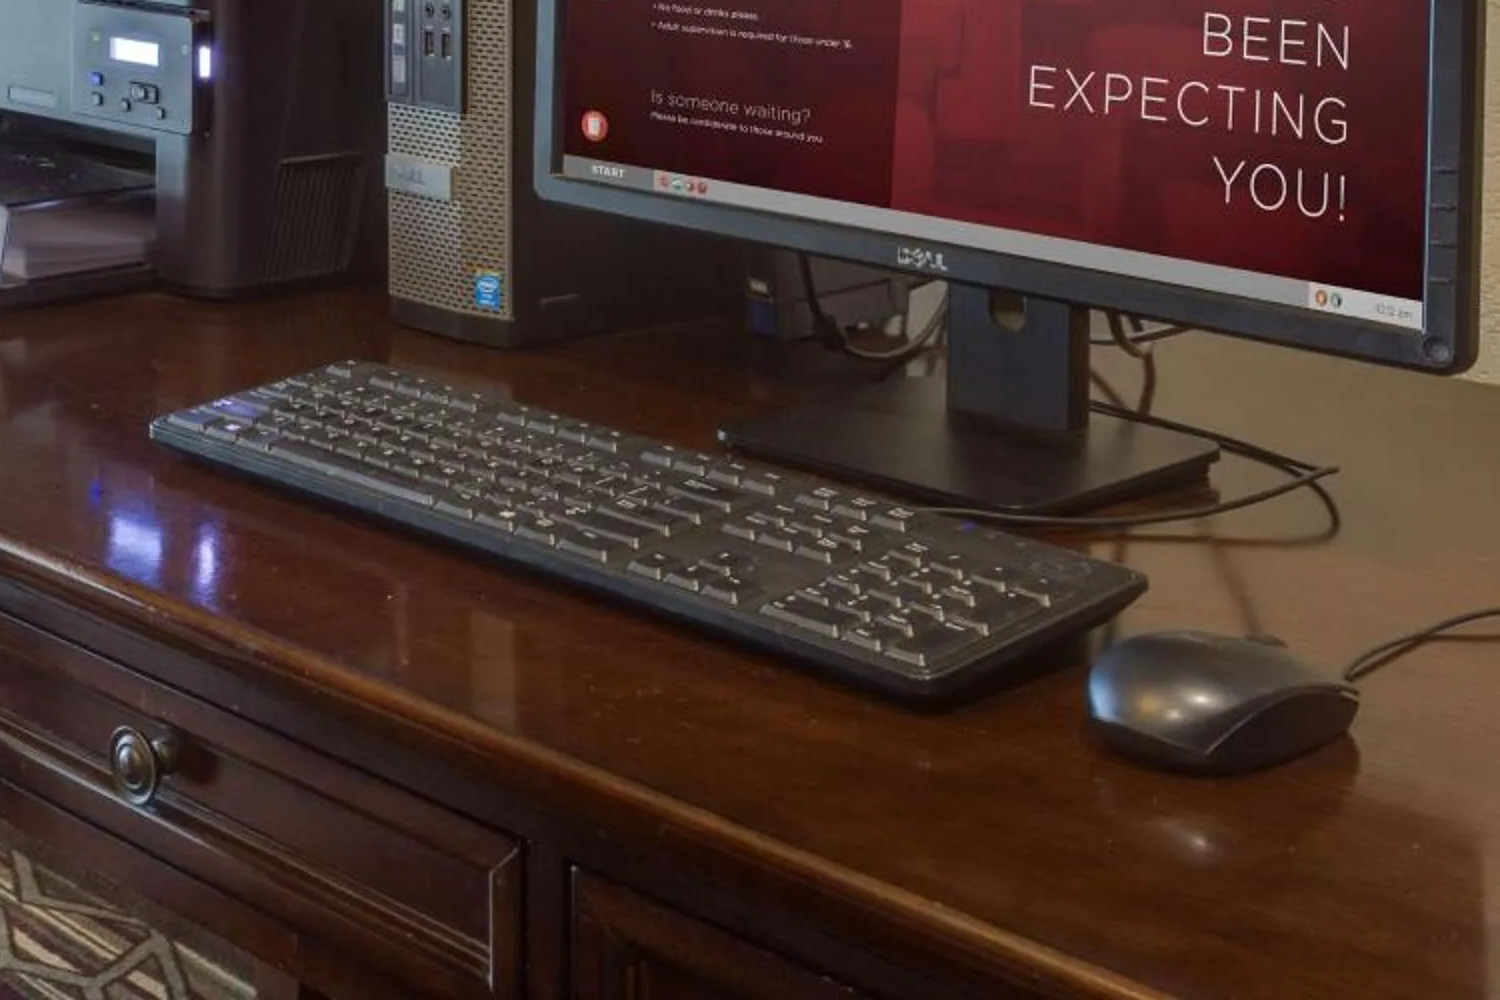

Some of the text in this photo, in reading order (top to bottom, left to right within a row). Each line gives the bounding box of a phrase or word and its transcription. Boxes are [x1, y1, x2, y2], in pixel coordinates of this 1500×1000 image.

[1202, 11, 1350, 71] BEEN
[651, 88, 812, 127] Is someone waiting?
[1028, 64, 1349, 146] EXPECTING
[590, 164, 626, 179] START
[1212, 155, 1347, 222] YOU!
